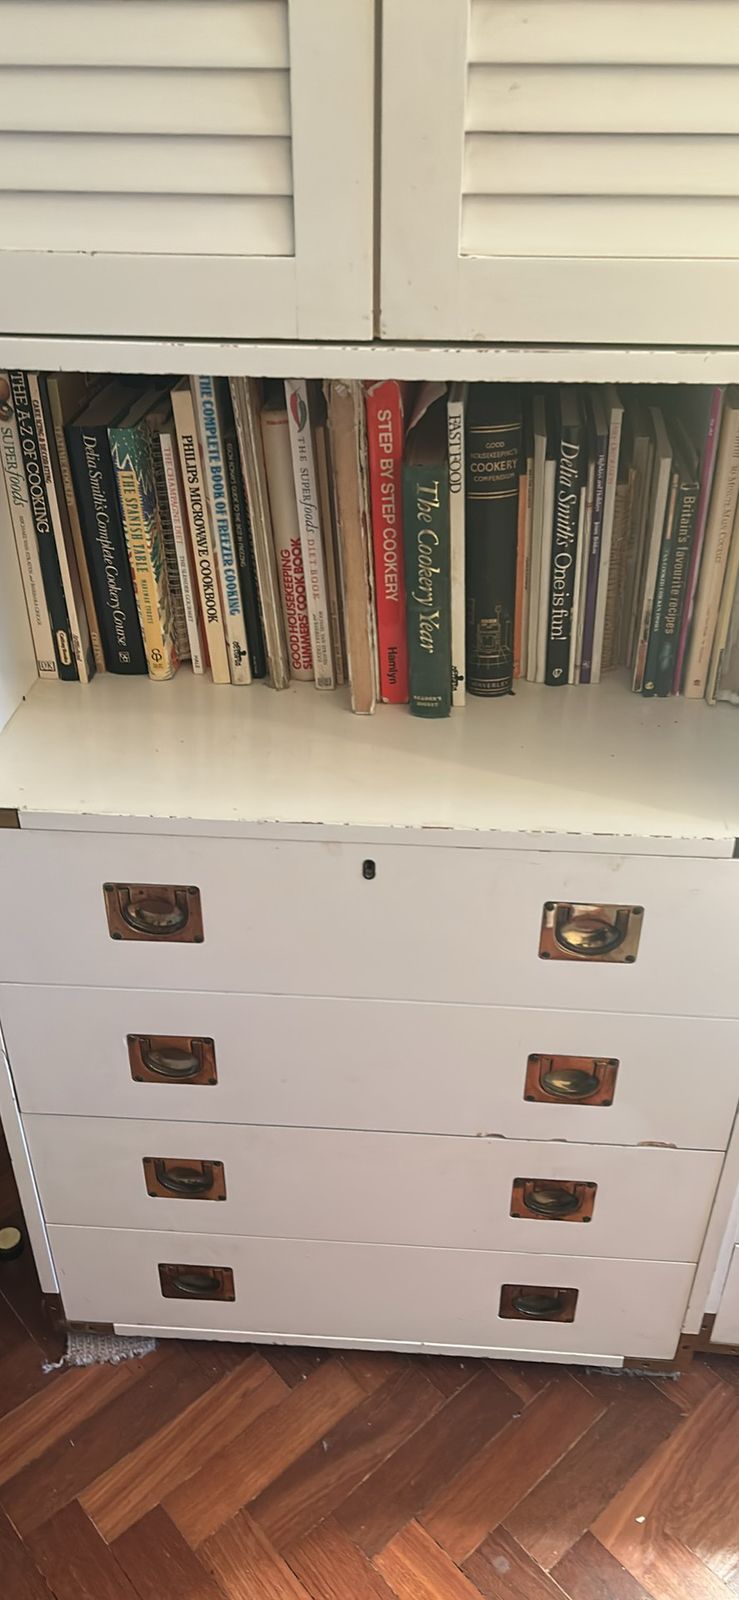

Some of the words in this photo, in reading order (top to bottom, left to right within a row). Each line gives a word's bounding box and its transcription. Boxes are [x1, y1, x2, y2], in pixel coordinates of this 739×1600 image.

[10, 372, 28, 406] THE
[199, 375, 212, 398] THE
[17, 409, 33, 436] A-Z
[202, 401, 221, 463] COMPLETE
[377, 409, 392, 454] STEP
[448, 415, 461, 451] FAST
[22, 439, 37, 460] OF
[83, 435, 100, 468] Delia
[164, 447, 173, 467] THE
[182, 435, 198, 484] PHILIPS
[298, 436, 307, 462] THE
[485, 441, 505, 449] GOOD
[560, 440, 579, 487] Delia
[121, 474, 136, 494] THE
[210, 466, 225, 499] BOOK
[380, 458, 393, 479] BY
[449, 453, 461, 493] FOOD
[470, 460, 517, 473] COOKERY
[26, 462, 50, 533] COOKING
[89, 469, 108, 511] Smith's
[215, 501, 227, 515] OF
[381, 483, 395, 524] STEP
[416, 480, 440, 522] The
[125, 498, 144, 540] SPANISH
[189, 487, 210, 557] MICROWAVE
[556, 490, 577, 548] Smith's
[678, 496, 696, 543] Britain's
[96, 512, 115, 565] Complete
[217, 519, 234, 566] FREEZER
[290, 538, 304, 574] BOOK
[308, 539, 317, 565] DIET
[132, 543, 148, 573] TABLE
[383, 528, 398, 602] COOKERY
[411, 529, 440, 606] Cookery
[554, 552, 572, 590] One
[670, 546, 689, 595] favourite
[105, 566, 121, 609] Cookery
[200, 559, 218, 624] COOKBOOK
[224, 569, 240, 616] COOKING
[280, 549, 298, 633] HOUSEKEEPING
[294, 576, 307, 611] COOK
[311, 570, 320, 600] BOOK
[552, 592, 570, 606] is
[113, 610, 127, 646] Course
[419, 610, 439, 654] Year
[551, 608, 569, 641] fun!
[664, 597, 679, 635] recipes
[289, 634, 301, 670] GOOD
[387, 647, 398, 684] Hamlyn
